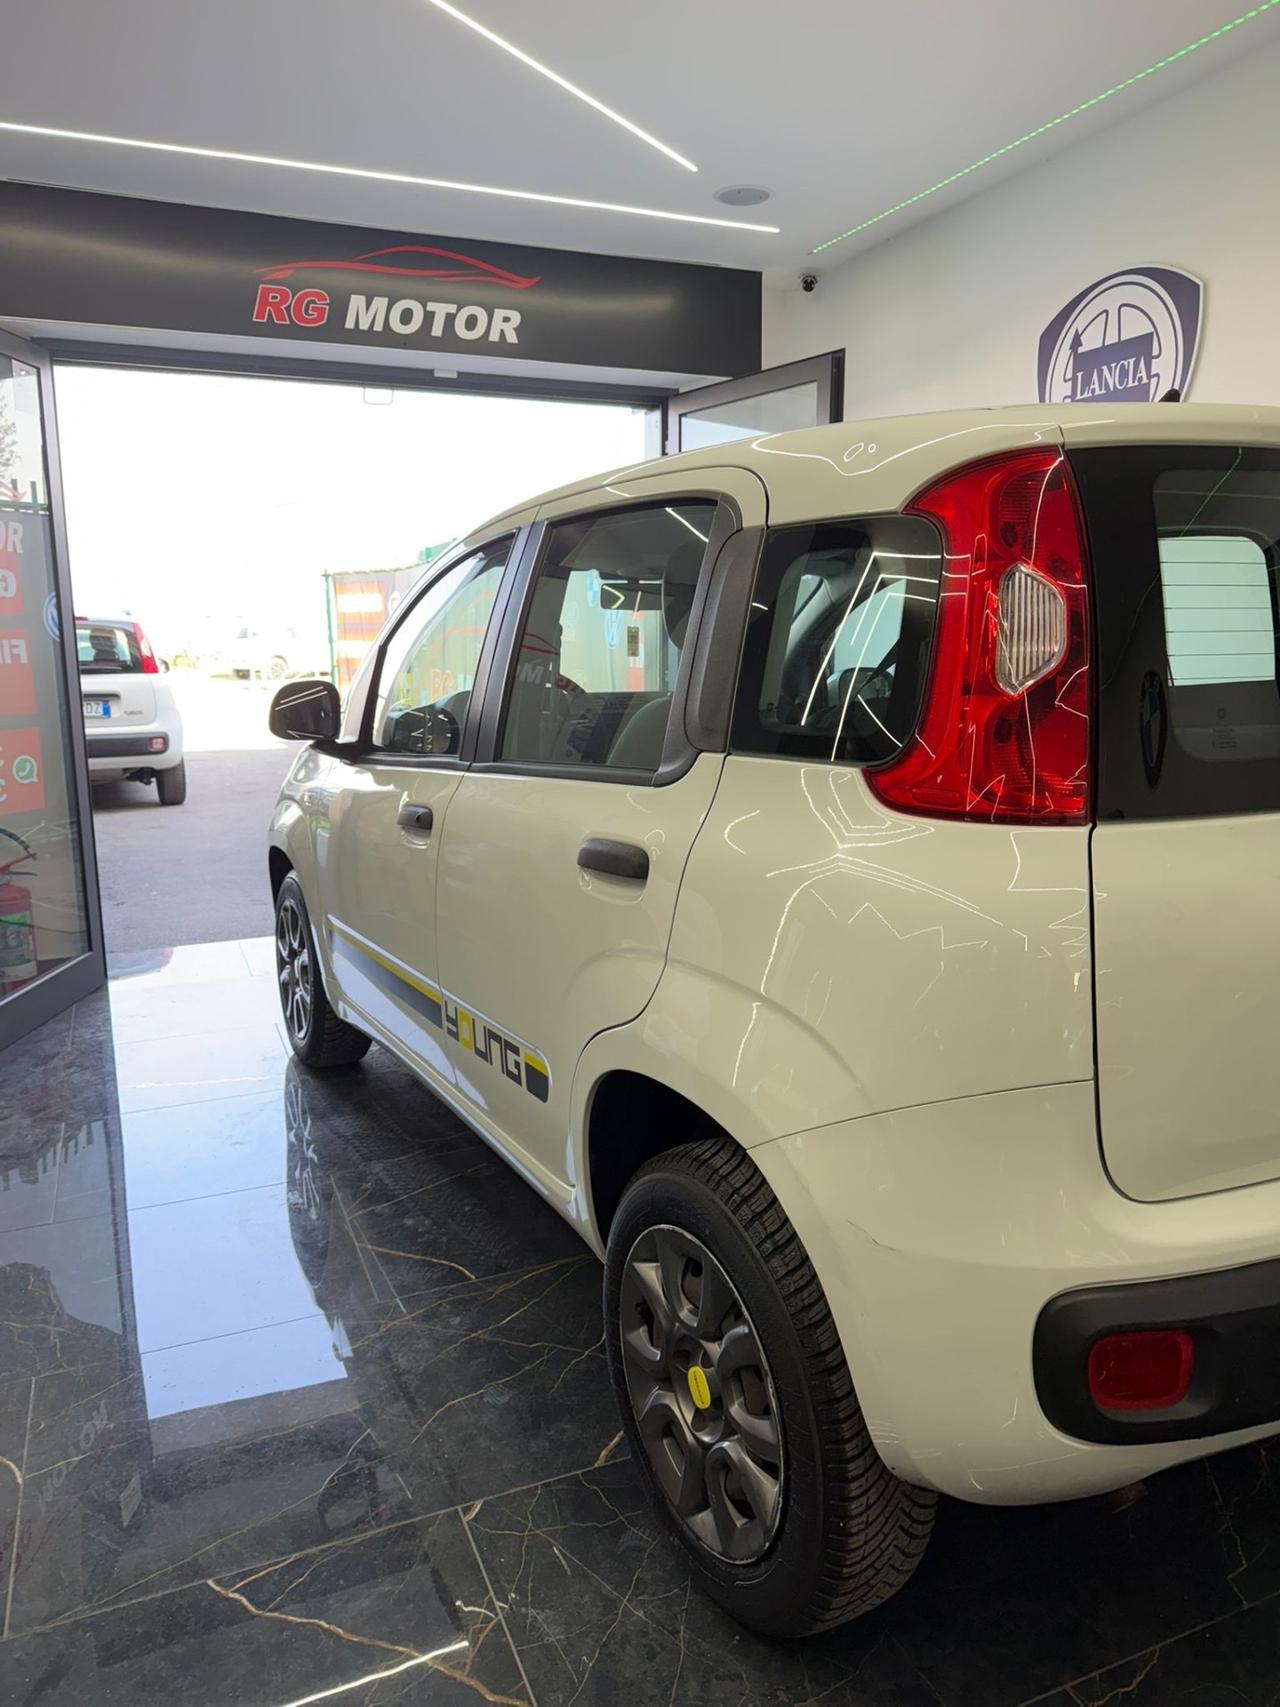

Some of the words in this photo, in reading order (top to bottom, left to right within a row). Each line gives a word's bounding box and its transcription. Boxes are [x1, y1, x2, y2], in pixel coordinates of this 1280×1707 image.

[252, 284, 329, 327] RG
[344, 294, 522, 344] MOTOR
[1075, 355, 1149, 400] LANCIA
[444, 999, 522, 1087] YOUNG
